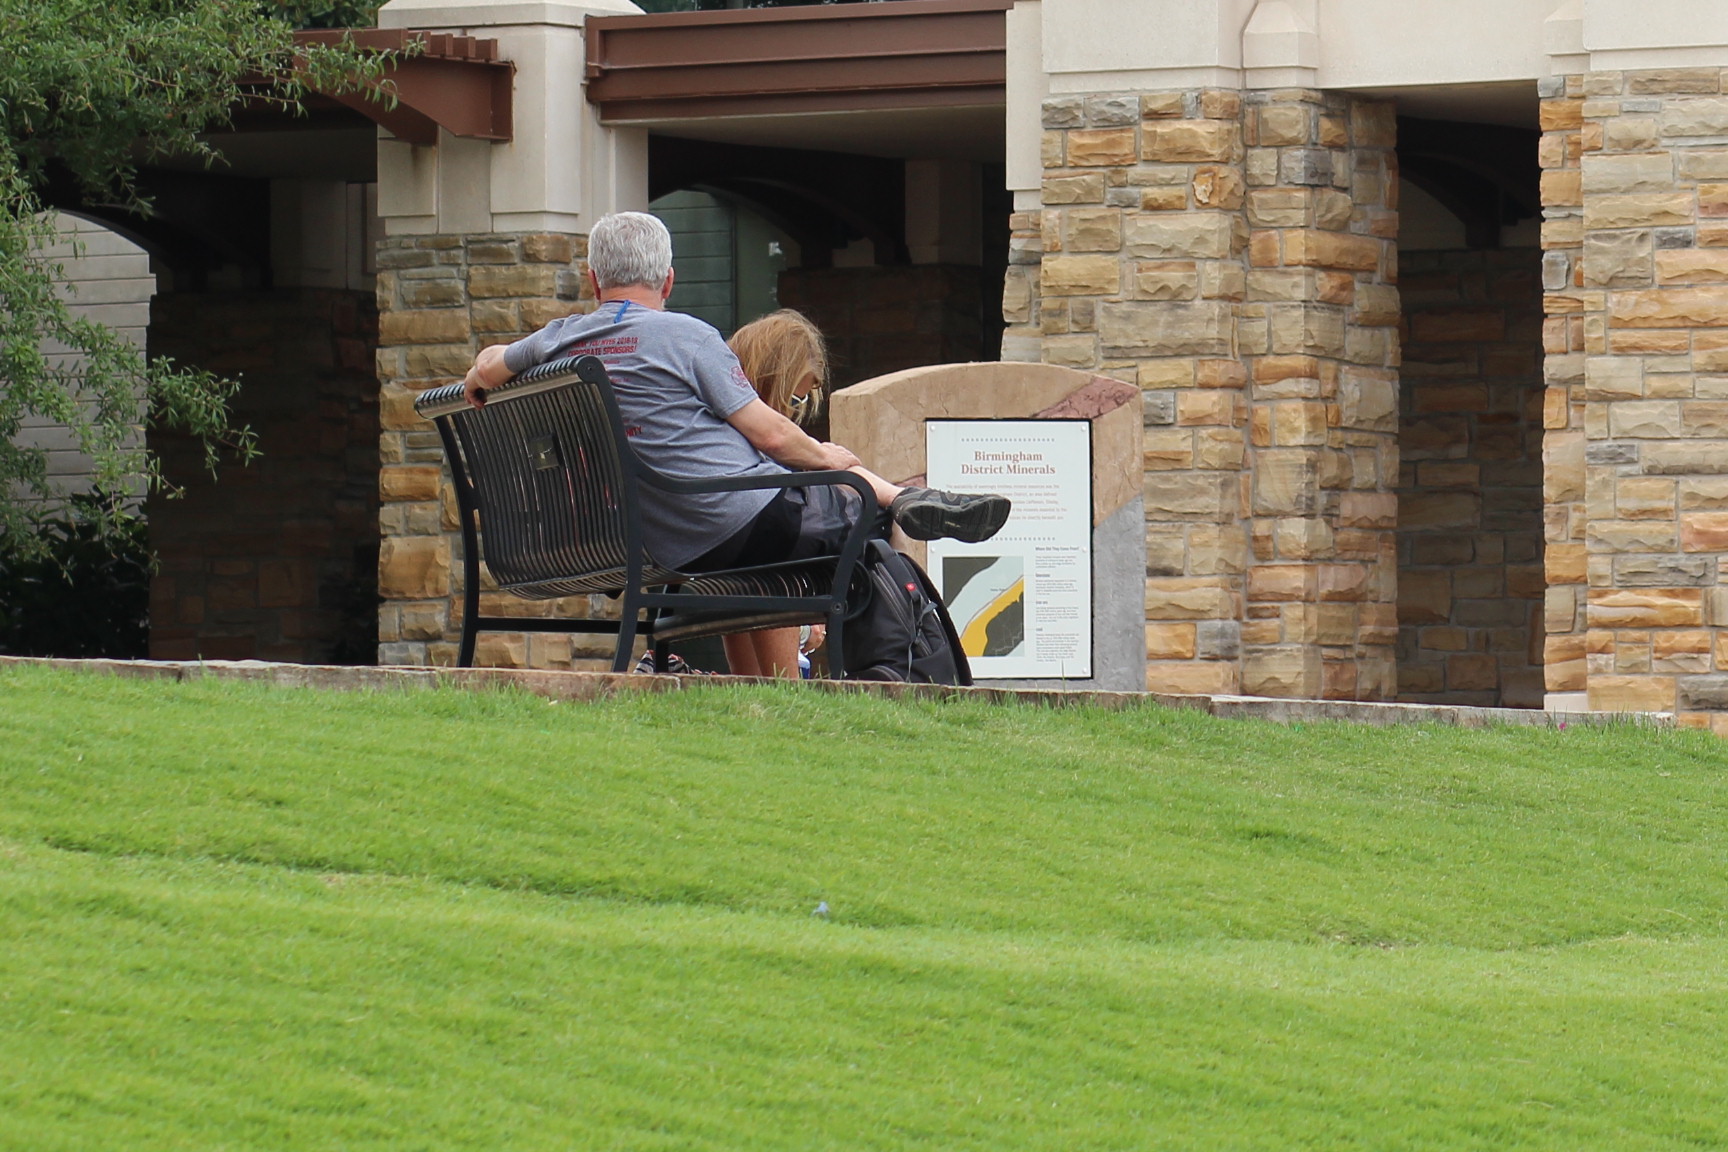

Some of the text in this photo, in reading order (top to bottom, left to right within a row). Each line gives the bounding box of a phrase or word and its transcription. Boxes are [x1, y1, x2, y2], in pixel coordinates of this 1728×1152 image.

[974, 450, 1043, 464] Birmingham
[961, 463, 1056, 475] District Minerals
